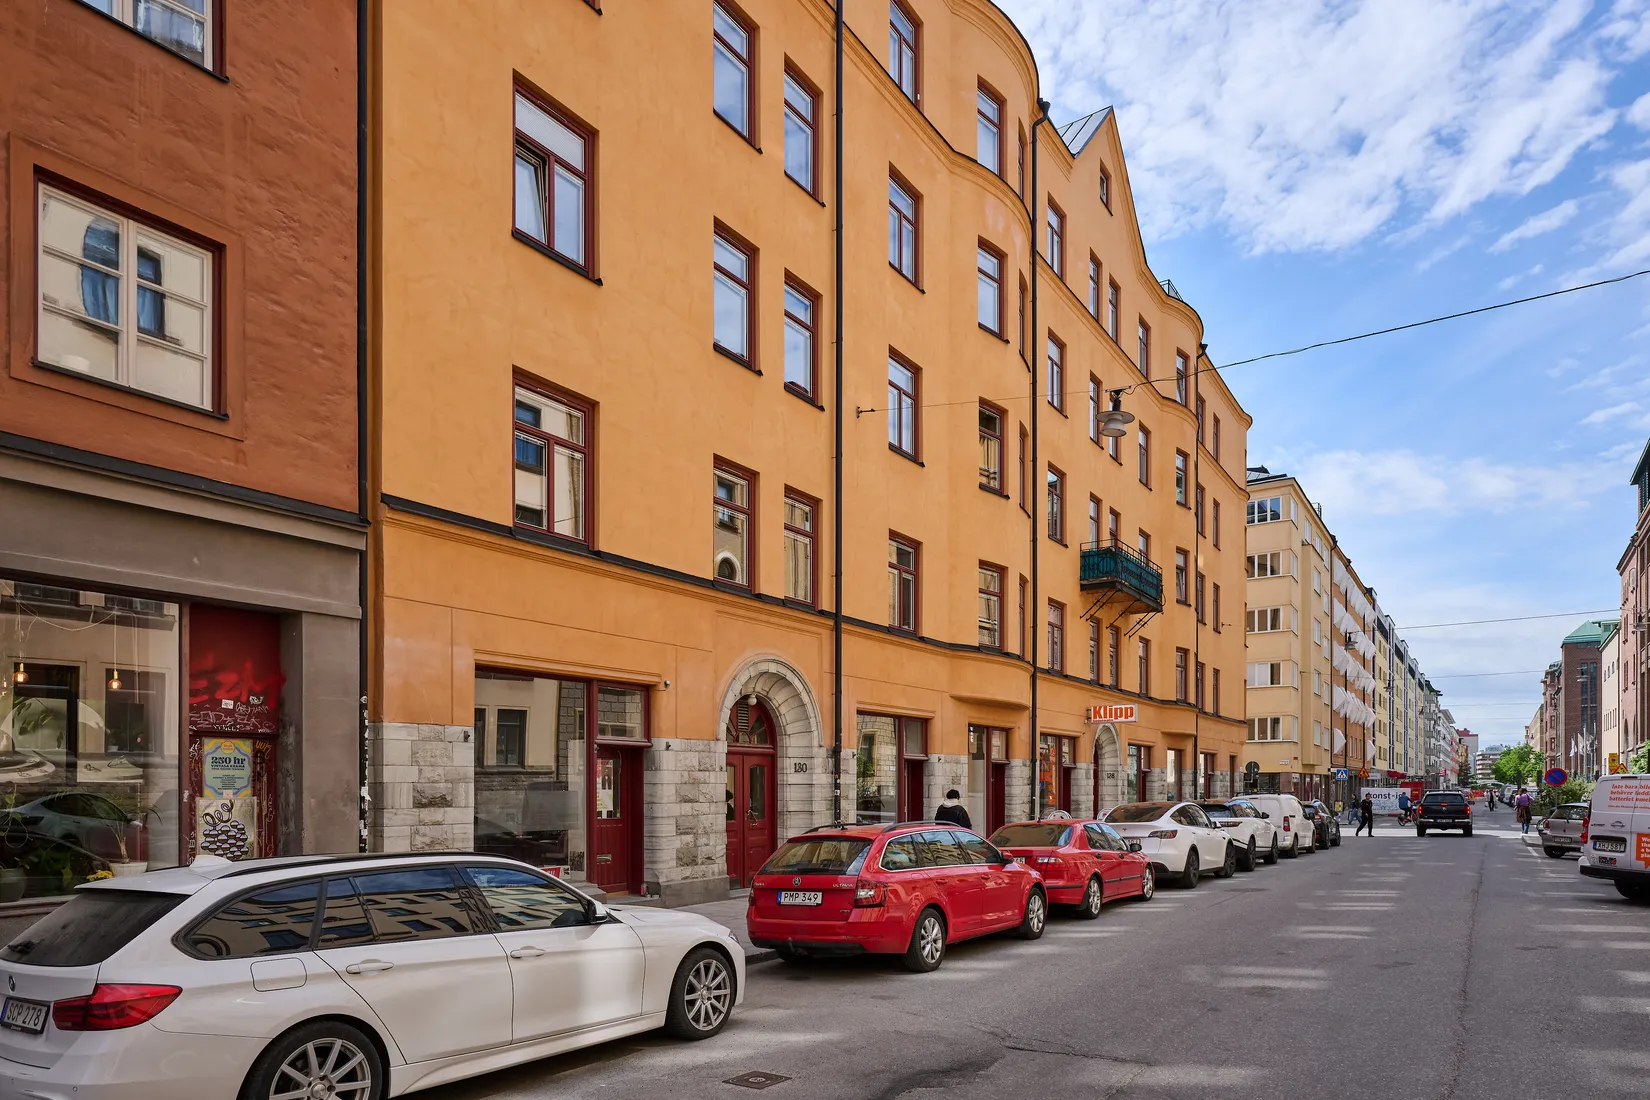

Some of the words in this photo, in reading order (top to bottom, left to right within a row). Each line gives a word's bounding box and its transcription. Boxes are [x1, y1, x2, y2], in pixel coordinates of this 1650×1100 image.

[1093, 705, 1134, 720] Klipp
[211, 756, 232, 765] 250
[234, 756, 246, 765] hr
[794, 762, 808, 773] 130
[783, 892, 800, 902] PMP
[801, 892, 819, 902] 349
[6, 1002, 24, 1022] SCP
[22, 1005, 42, 1027] 278
